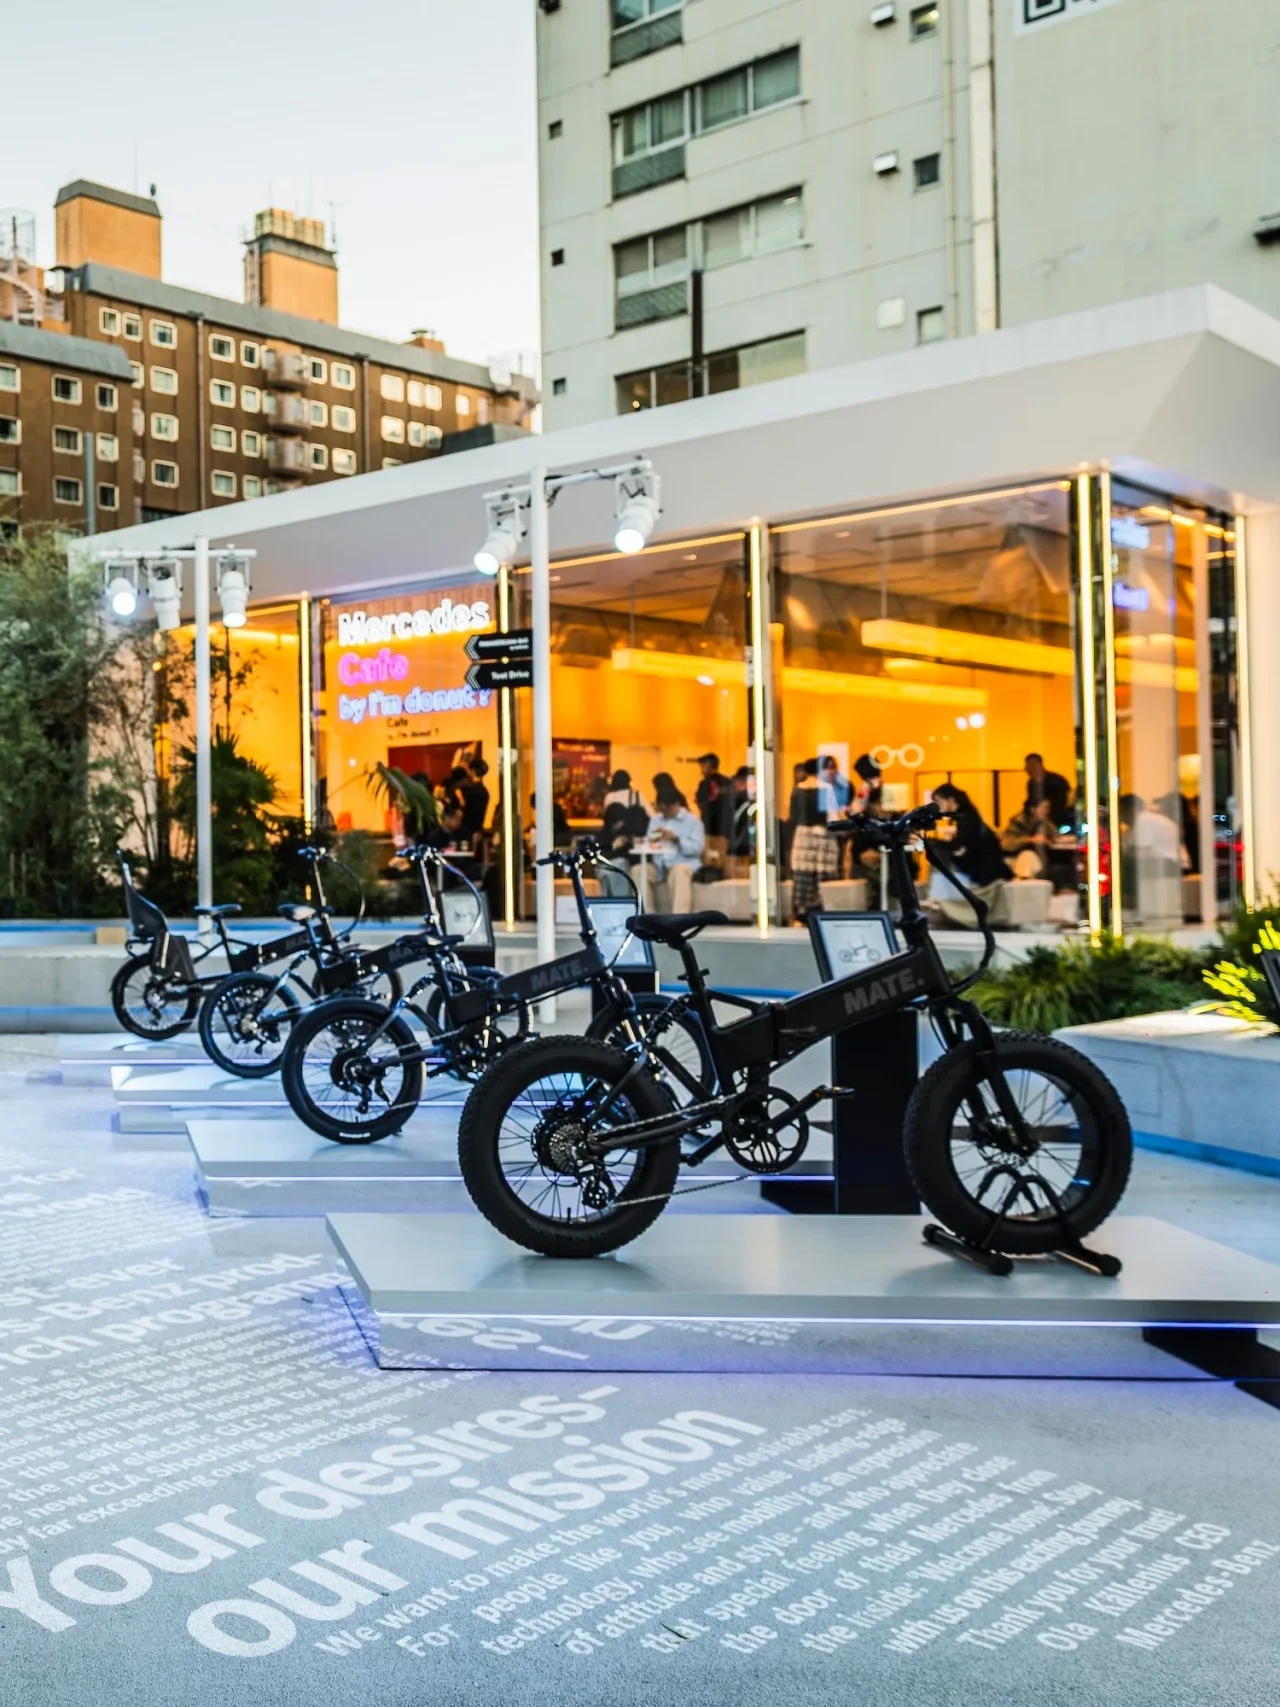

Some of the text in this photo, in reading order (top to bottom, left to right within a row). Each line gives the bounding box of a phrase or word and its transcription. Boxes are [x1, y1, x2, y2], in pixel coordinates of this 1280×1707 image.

[338, 598, 490, 647] Mercedes
[338, 648, 410, 686] Cafe
[339, 694, 366, 724] by
[369, 690, 403, 717] I'm
[404, 684, 476, 714] donut
[531, 960, 588, 991] MATE.
[843, 968, 924, 1016] MATE.
[188, 1252, 324, 1290] prod-
[6, 1483, 62, 1502] the
[60, 1463, 121, 1487] new
[122, 1434, 220, 1466] electric
[214, 1418, 269, 1437] GLC
[260, 1412, 293, 1423] is
[16, 1388, 142, 1428] electrified
[17, 1460, 70, 1480] the
[75, 1433, 159, 1462] safest
[162, 1420, 201, 1436] car
[204, 1396, 285, 1422] tested
[280, 1387, 319, 1401] by
[41, 1418, 94, 1434] We
[59, 1427, 122, 1448] with
[116, 1406, 196, 1431] being
[255, 1385, 622, 1521] desires-
[24, 1493, 88, 1519] new
[87, 1473, 152, 1496] CLA
[144, 1438, 269, 1478] Shooting
[255, 1418, 330, 1443] Brake.
[26, 1518, 74, 1540] far
[76, 1474, 219, 1524] exceeding
[210, 1459, 256, 1478] our
[255, 1413, 402, 1464] expectations.
[186, 1410, 768, 1657] our mission
[315, 1406, 874, 1656] We want to make the world's most desirable cars.
[395, 1622, 462, 1658] For
[472, 1571, 570, 1625] people
[562, 1546, 624, 1574] like
[620, 1523, 685, 1552] you,
[677, 1494, 733, 1522] who
[730, 1468, 794, 1498] value
[481, 1427, 944, 1657] technology, who see mobility as an expression
[565, 1441, 979, 1657] of attitude and style and who appreciate
[641, 1455, 1017, 1655] that special feeling when they close
[720, 1467, 1059, 1655] the door of their Mercedes from
[800, 1623, 858, 1654] the
[1041, 1481, 1104, 1509] Stay
[883, 1496, 1146, 1656] with us on this exciting journey.
[1036, 1522, 1232, 1652] Ola Källenius CEO
[955, 1536, 1144, 1652] Thank you for your
[1115, 1539, 1280, 1652] Mercedes-Benz
